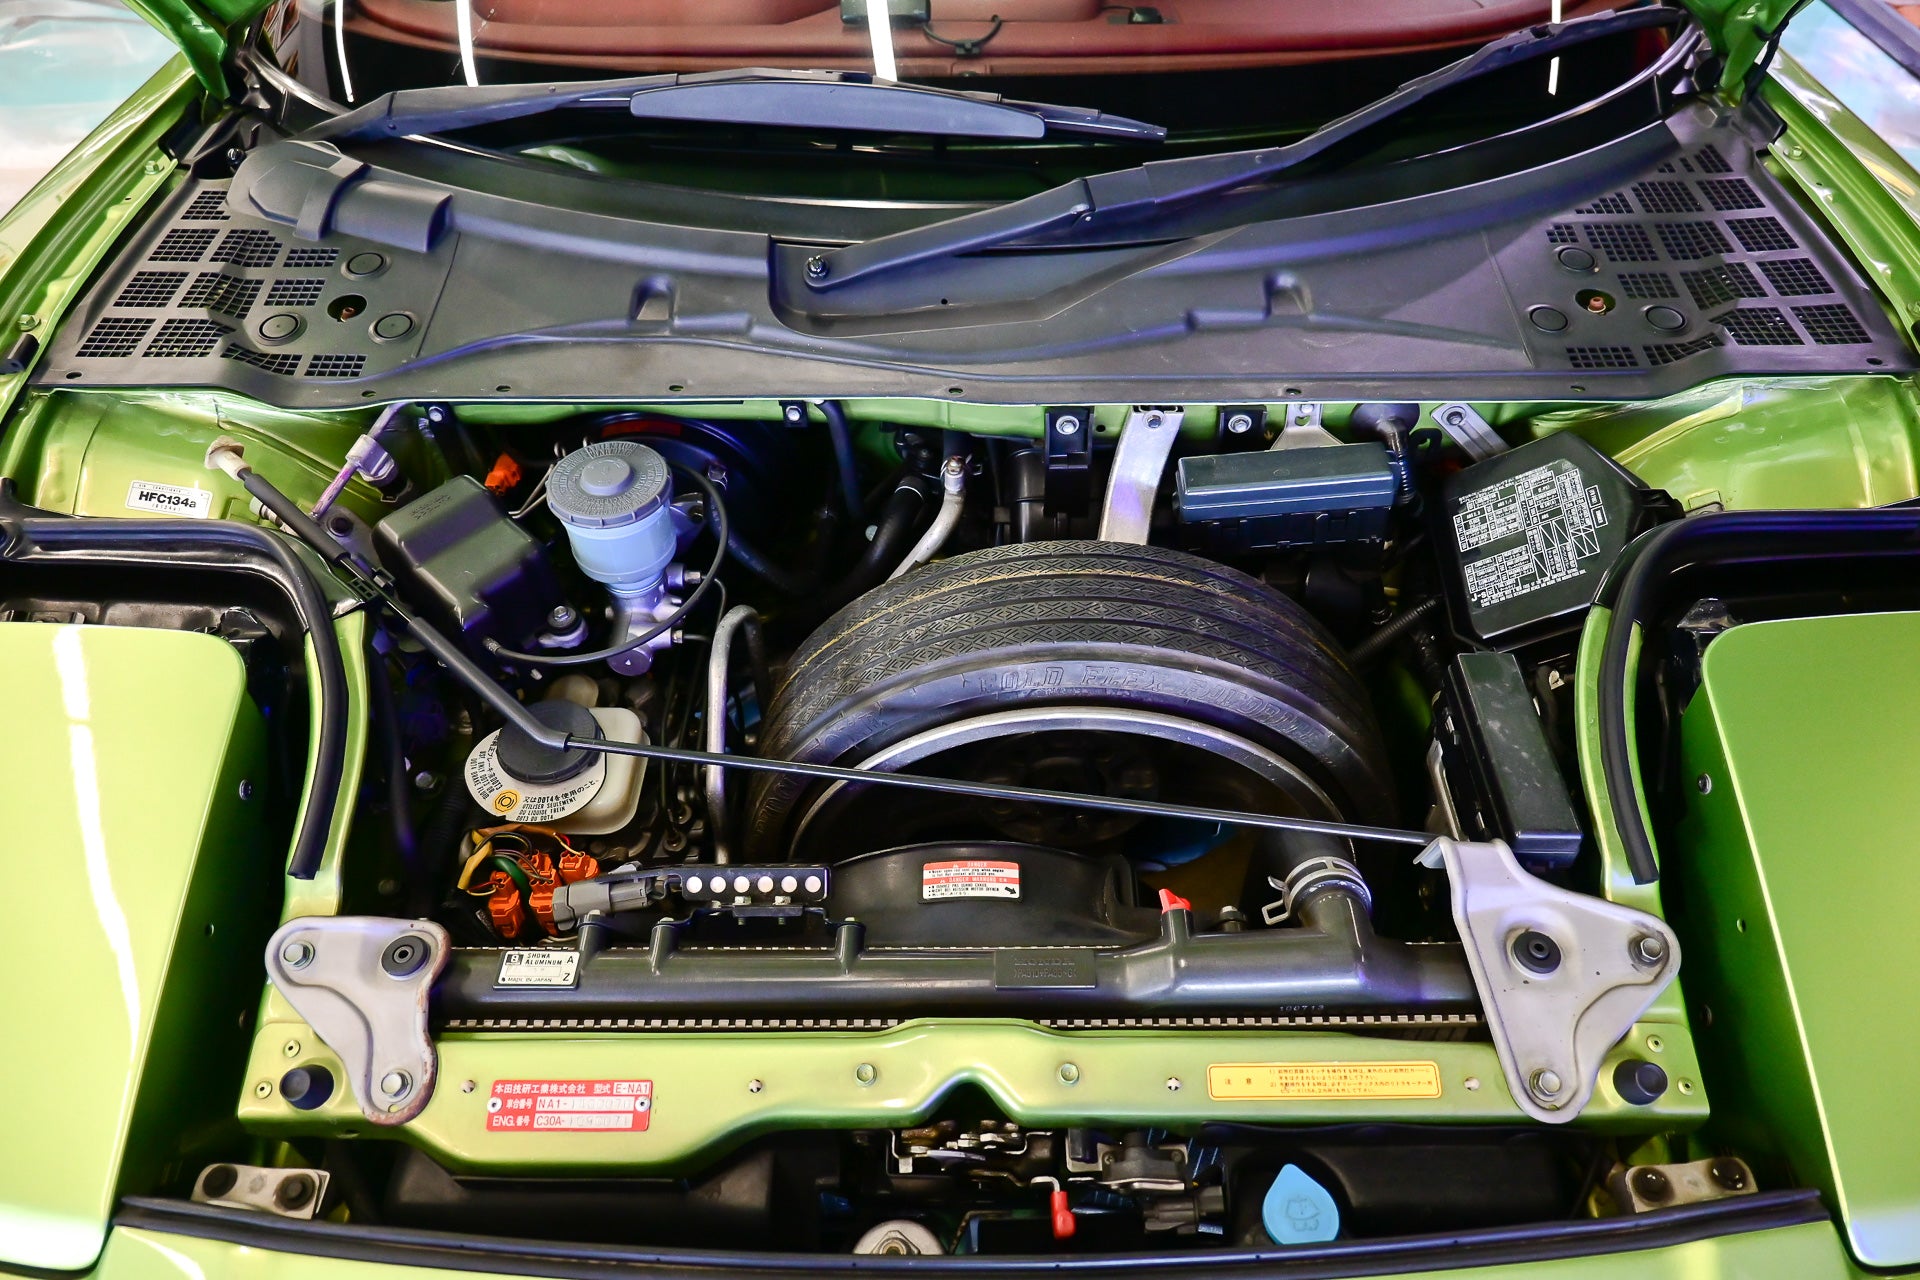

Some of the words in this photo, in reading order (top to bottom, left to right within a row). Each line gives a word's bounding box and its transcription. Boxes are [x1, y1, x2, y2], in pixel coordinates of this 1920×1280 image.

[139, 490, 197, 508] HFC134a
[566, 955, 574, 964] A
[562, 972, 570, 982] Z
[494, 1083, 586, 1094] 本田技研工業株式会社
[593, 1083, 611, 1094] 型式
[615, 1083, 648, 1094] E-NA1
